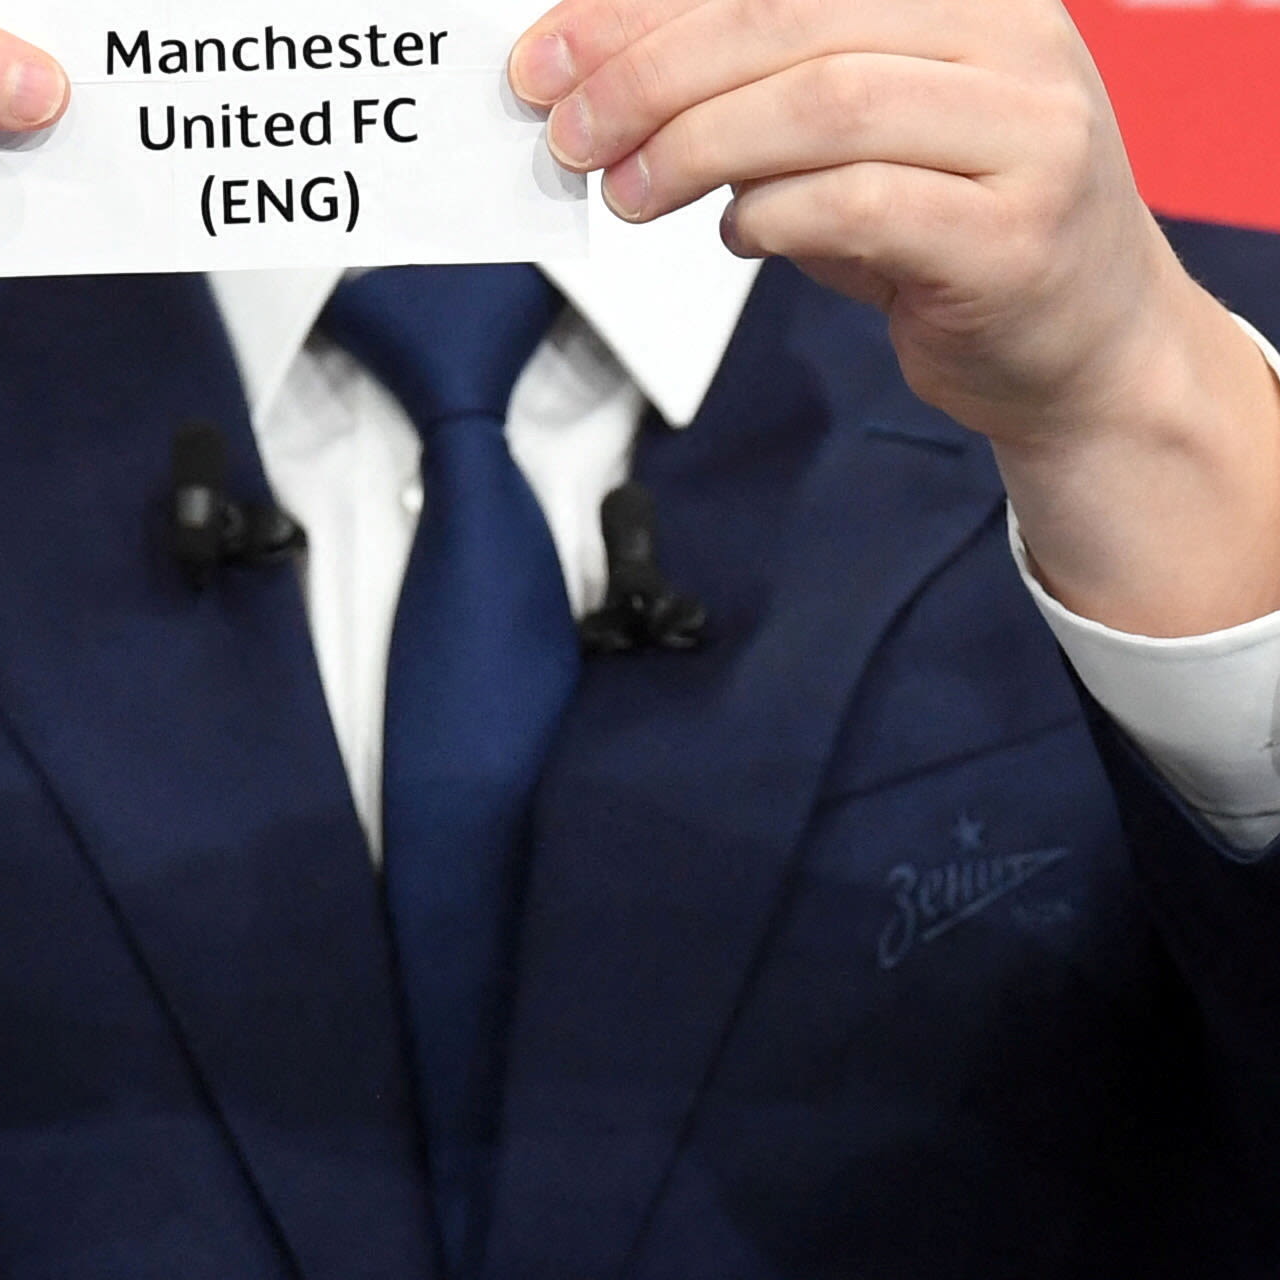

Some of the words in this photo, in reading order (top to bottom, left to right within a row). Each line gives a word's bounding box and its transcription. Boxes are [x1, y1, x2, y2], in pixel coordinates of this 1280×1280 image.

[106, 25, 448, 75] Manchester
[139, 101, 333, 151] United
[353, 97, 419, 144] FC
[200, 170, 361, 237] (ENG)
